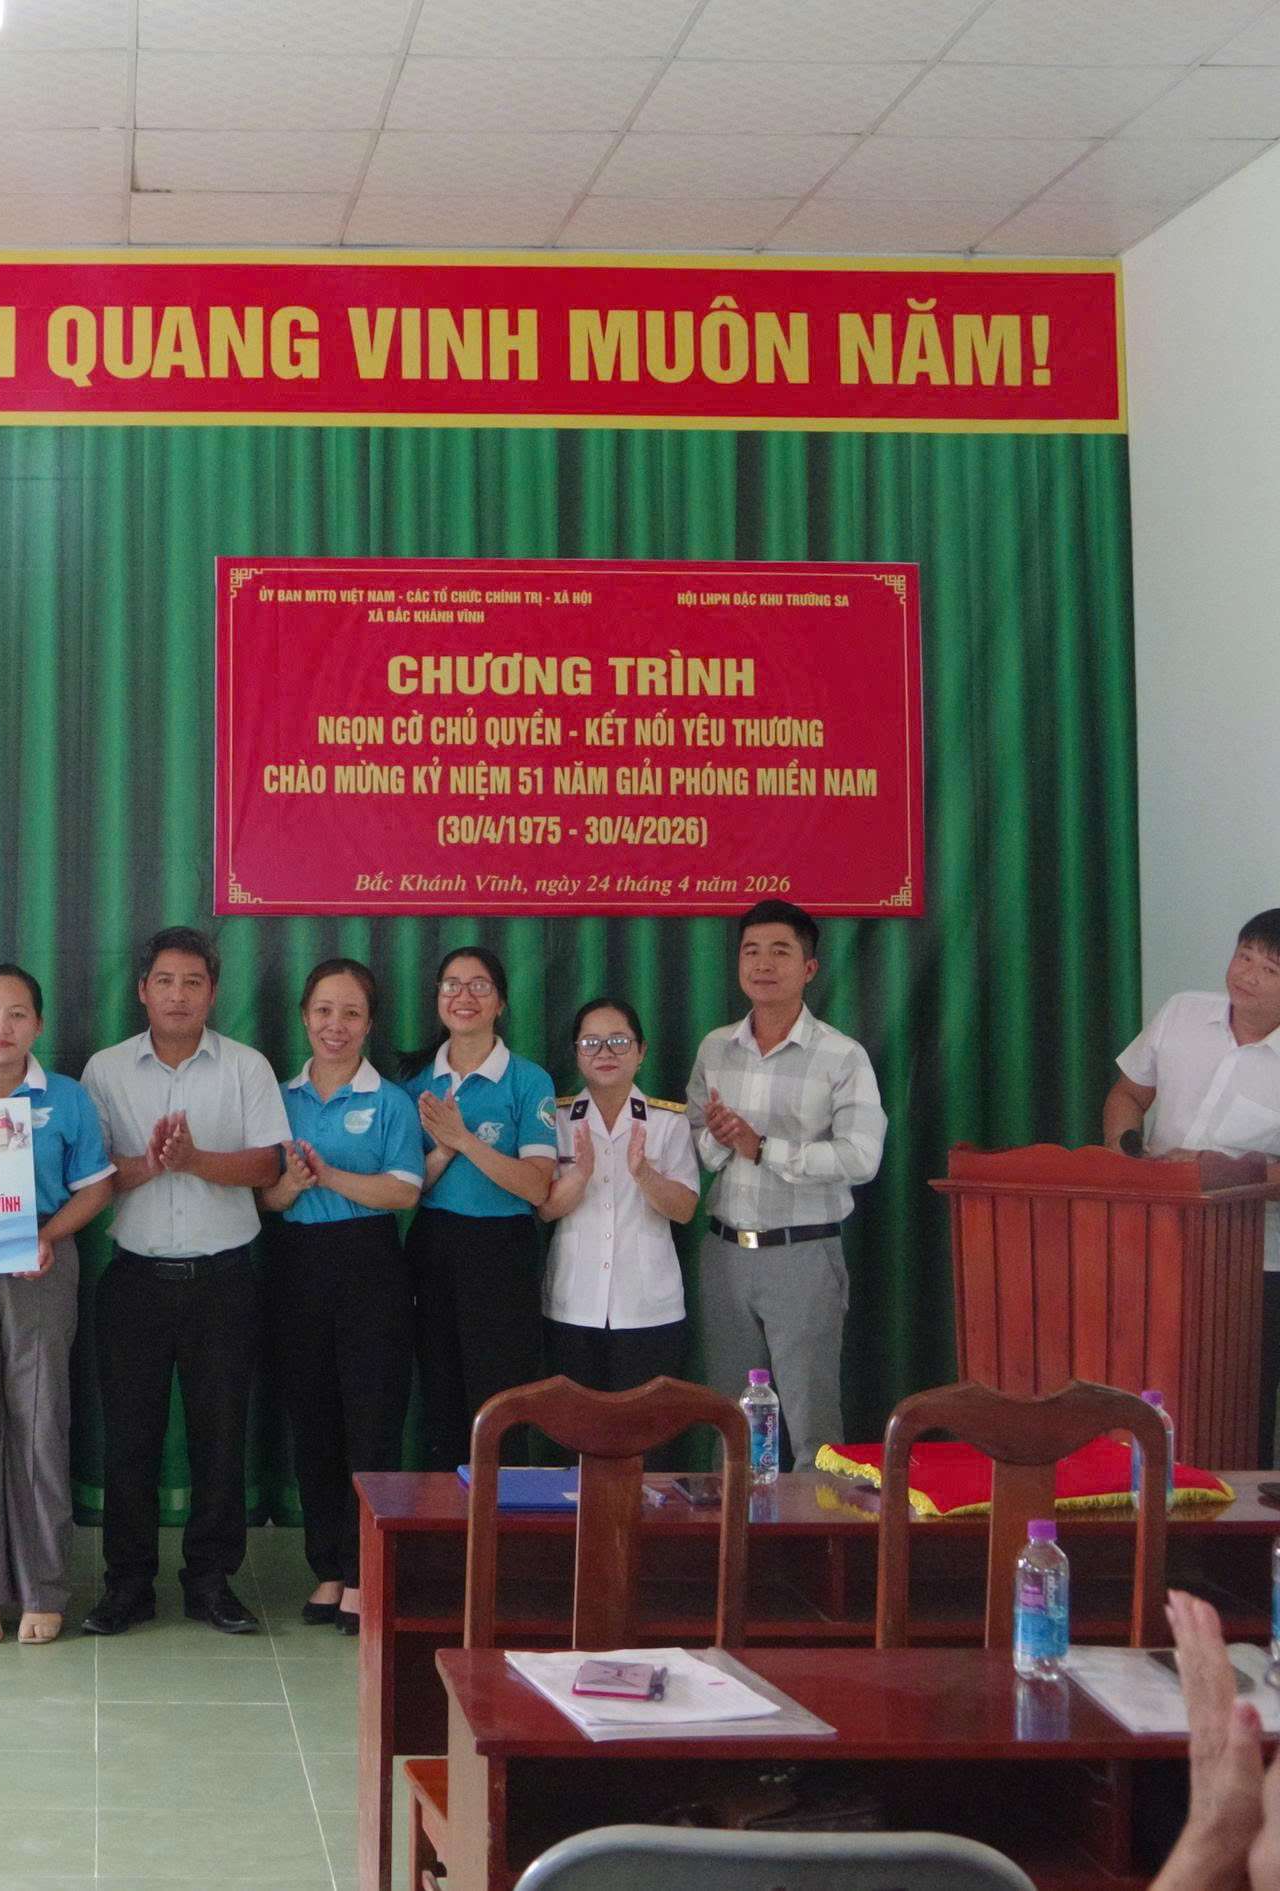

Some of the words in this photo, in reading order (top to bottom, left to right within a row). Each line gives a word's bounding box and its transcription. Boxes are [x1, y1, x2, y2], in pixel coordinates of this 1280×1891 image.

[48, 305, 319, 387] QUANG
[348, 308, 538, 380] VINH
[569, 296, 809, 384] MUÔN
[839, 298, 1050, 386] NĂM!
[260, 586, 274, 601] ỦY
[278, 590, 302, 601] BAN
[305, 590, 336, 603] MTTQ
[340, 588, 364, 604] VIỆT
[368, 591, 395, 602] NAM
[407, 589, 429, 602] CÁC
[433, 587, 447, 603] TỔ
[451, 590, 481, 603] CHỨC
[485, 590, 521, 603] CHÍNH
[524, 592, 542, 606] TRỊ
[573, 591, 592, 606] HỘI
[678, 591, 697, 607] HỘI
[700, 593, 730, 605] LHPN
[733, 592, 756, 607] ĐẶC
[760, 594, 782, 605] KHU
[835, 595, 849, 606] SA
[414, 609, 454, 622] KHÁNH
[457, 609, 484, 622] VĨNH
[388, 653, 591, 695] CHƯƠNG
[608, 650, 754, 696] TRÌNH
[318, 716, 384, 750] NGỌN
[392, 710, 423, 745] CỜ
[431, 708, 477, 745] CHỦ
[485, 709, 561, 748] QUYỀN
[586, 709, 627, 746] KẾT
[635, 709, 674, 746] NỐI
[682, 713, 725, 746] YÊU
[732, 716, 823, 747] THƯƠNG
[264, 759, 326, 793] CHÀO
[335, 760, 404, 794] MỪNG
[413, 757, 442, 794] KỶ
[450, 761, 510, 800] NIỆM
[519, 767, 543, 795] 51
[554, 761, 608, 794] NĂM
[616, 758, 662, 795] GIẢI
[670, 762, 748, 795] PHÓNG
[757, 759, 816, 796] MIỀN
[824, 768, 877, 796] NAM
[438, 816, 561, 846] (30/4/1975
[585, 816, 707, 847] 30/4/2026)
[355, 872, 392, 891] Bắc
[400, 875, 466, 891] Khánh
[476, 875, 527, 894] Vĩnh,
[536, 875, 581, 896] ngày
[587, 875, 610, 891] 24
[616, 875, 672, 896] tháng
[678, 876, 689, 891] 4
[696, 876, 737, 892] năm
[744, 876, 790, 892] 2026
